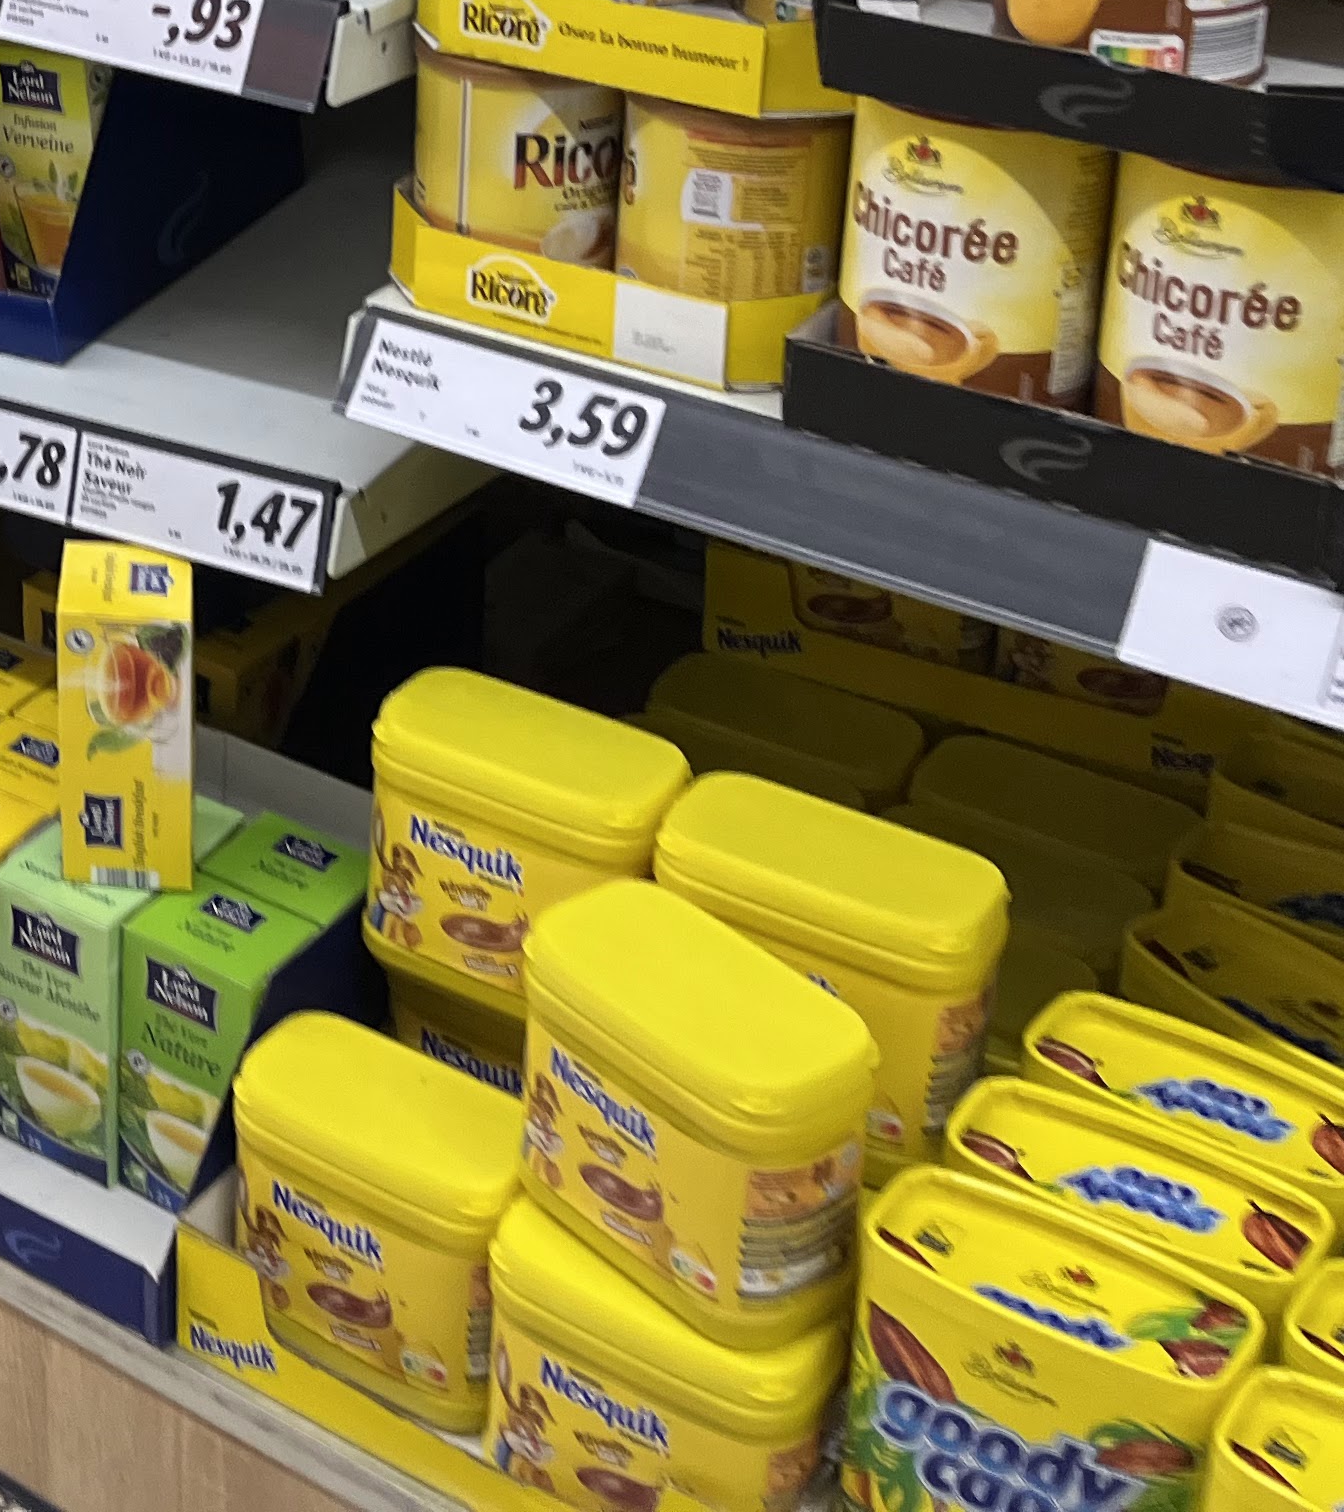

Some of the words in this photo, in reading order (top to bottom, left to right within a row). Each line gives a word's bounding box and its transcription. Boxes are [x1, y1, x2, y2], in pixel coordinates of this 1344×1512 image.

[463, 0, 546, 47] Ricoré
[558, 21, 597, 42] Osez
[599, 28, 614, 46] la
[617, 31, 668, 56] bonne
[672, 42, 739, 72] humeur
[3, 127, 74, 156] Verveine
[852, 180, 1019, 265] Chicorée
[471, 269, 550, 318] Ricoré
[882, 247, 947, 293] Café
[1117, 241, 1302, 332] Chicorée
[378, 338, 433, 367] Nestlé
[1153, 311, 1224, 361] Café
[372, 358, 440, 391] Nesquik
[518, 379, 648, 457] 3,59
[215, 481, 317, 551] 1,47
[409, 813, 524, 885] Nesquik
[141, 1022, 223, 1079] Nature
[549, 1046, 658, 1151] Nesquik
[271, 1181, 384, 1263] Nesquik
[189, 1323, 278, 1375] Nesquik
[540, 1355, 669, 1446] Nesquik
